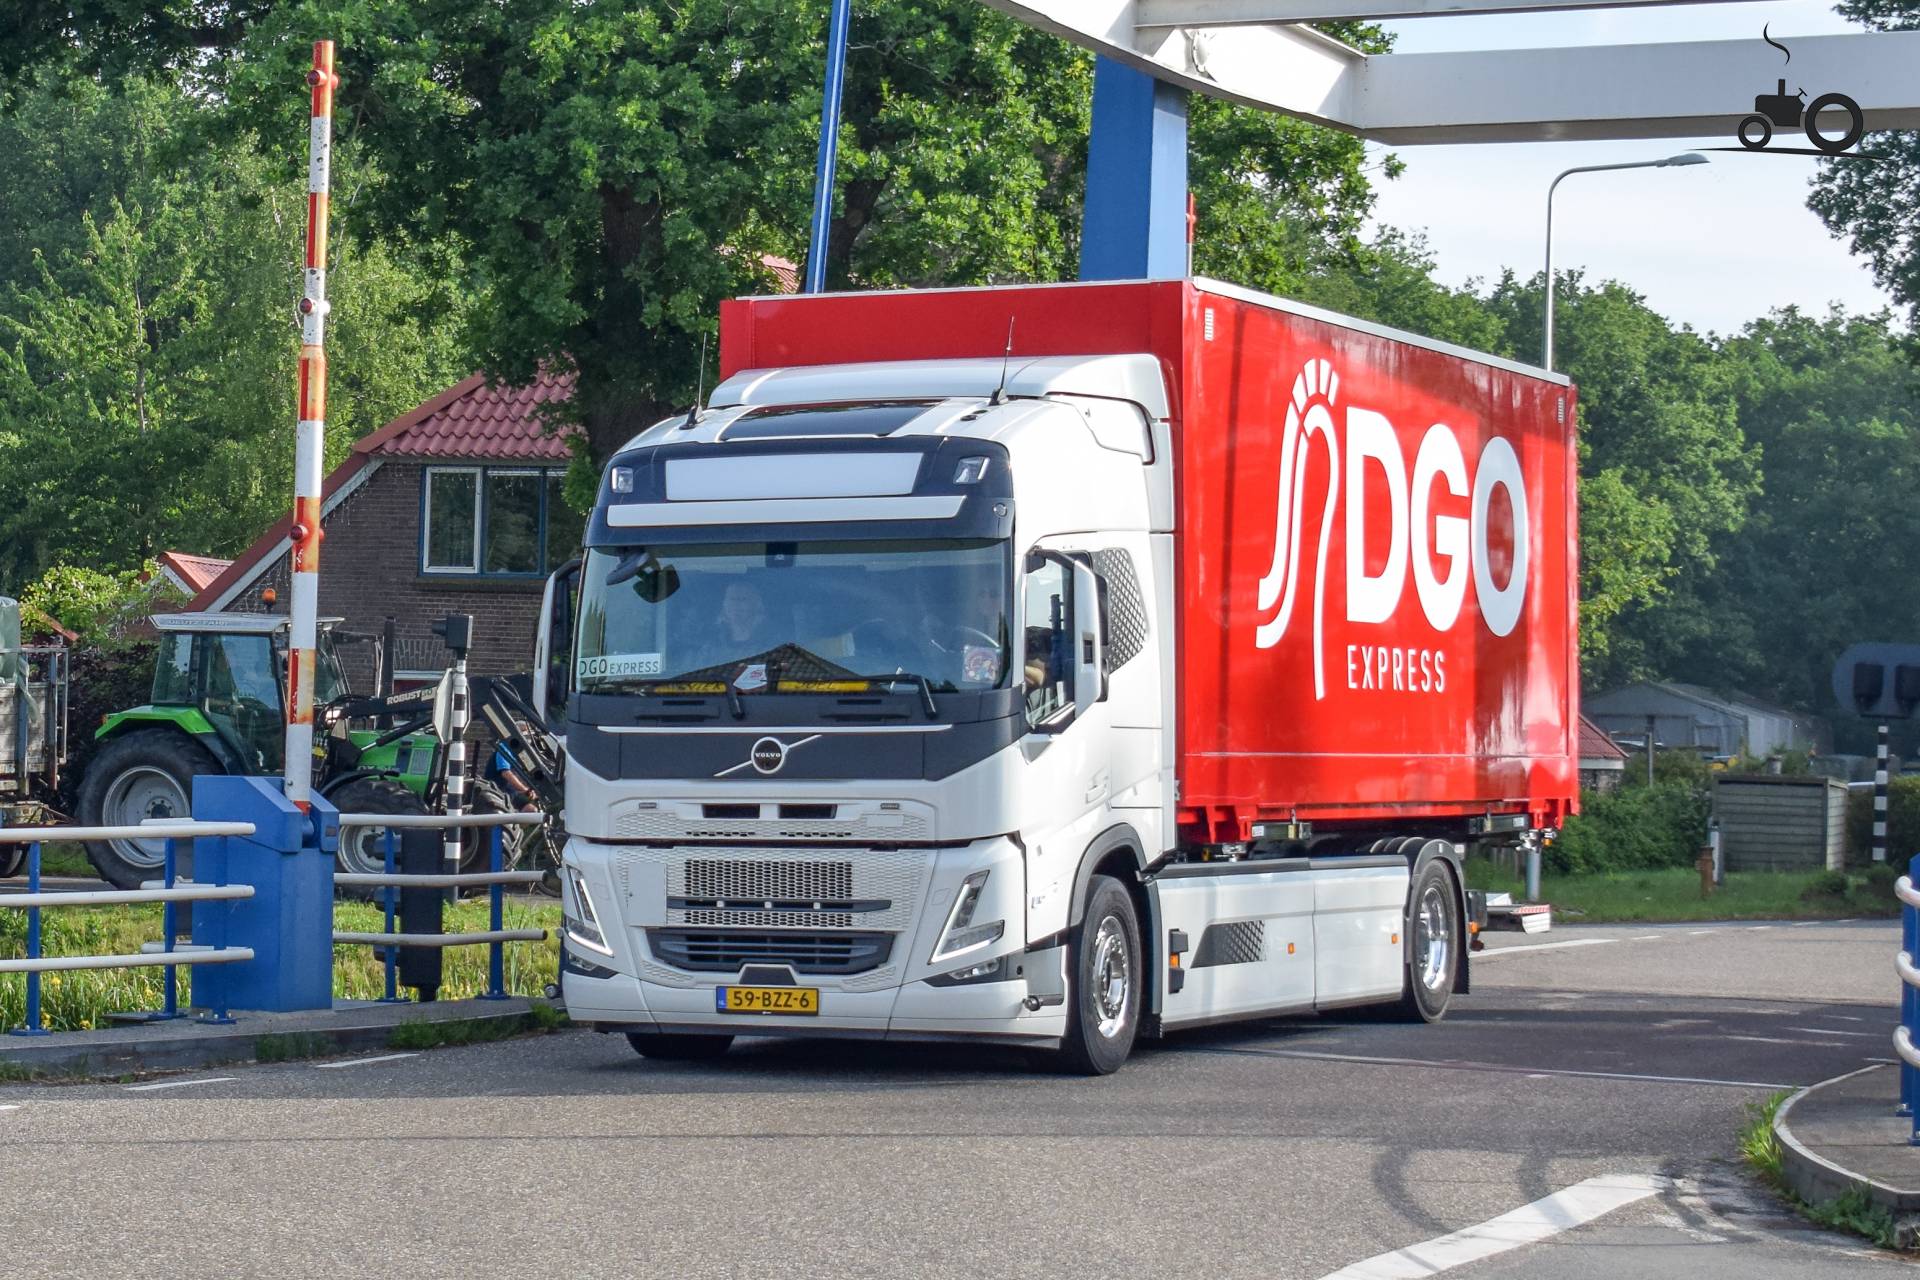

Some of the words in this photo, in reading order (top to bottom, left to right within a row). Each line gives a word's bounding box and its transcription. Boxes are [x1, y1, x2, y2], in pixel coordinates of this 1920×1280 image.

[1346, 406, 1529, 637] DGO
[578, 658, 608, 676] DGO
[609, 660, 659, 674] EXPRESS
[1347, 645, 1446, 694] EXPRESS
[386, 689, 421, 706] ROBUST
[733, 990, 810, 1008] 59-BZZ-6
